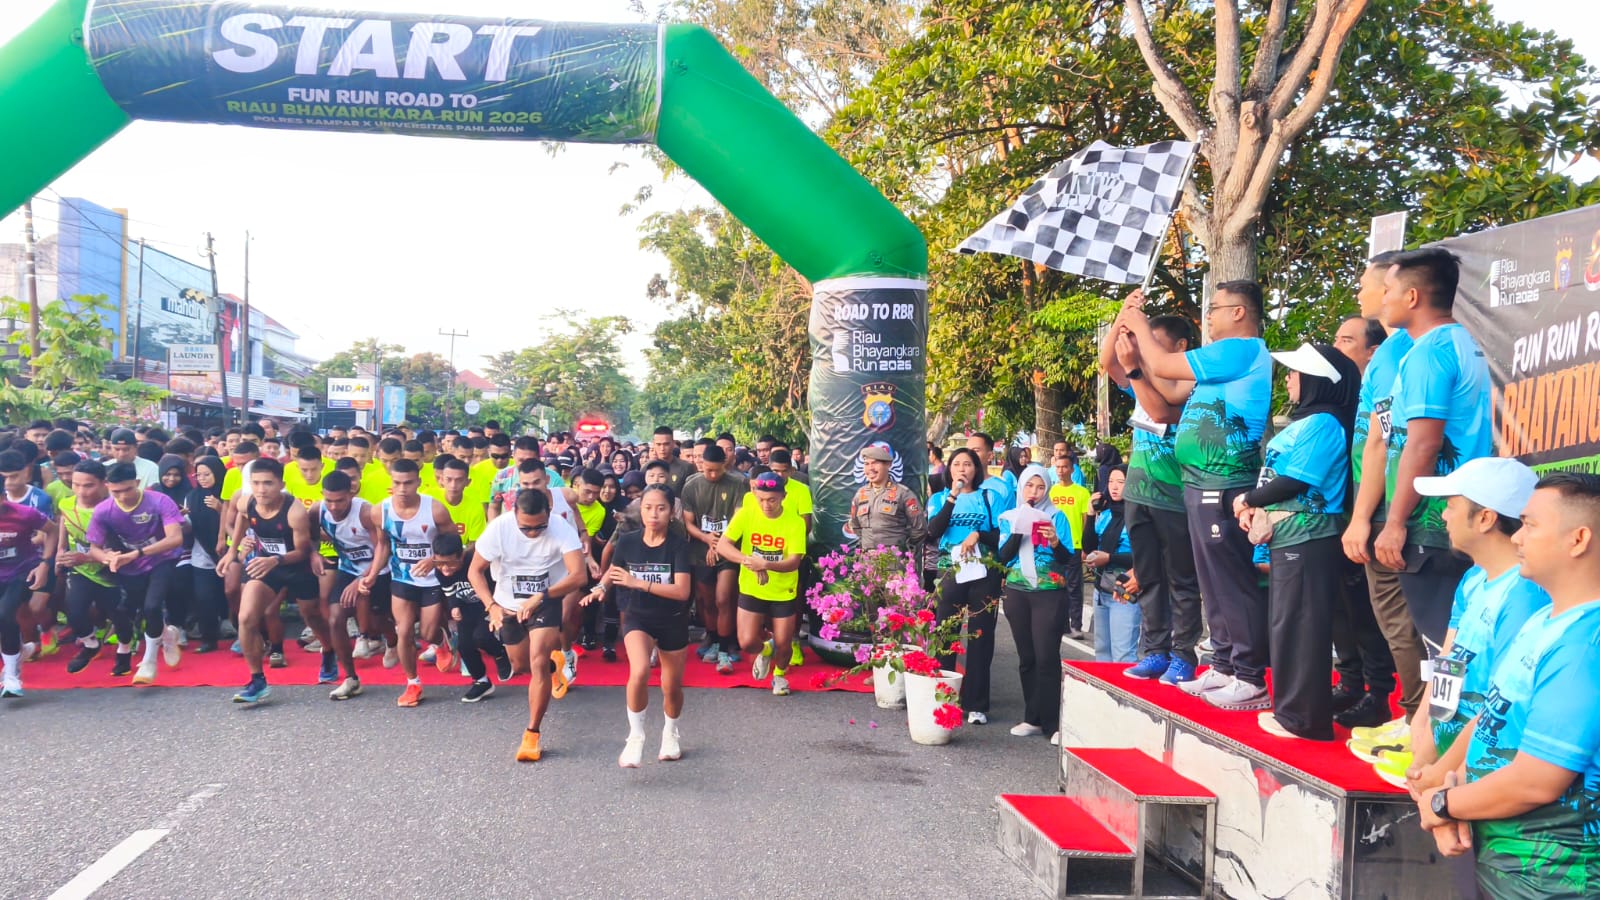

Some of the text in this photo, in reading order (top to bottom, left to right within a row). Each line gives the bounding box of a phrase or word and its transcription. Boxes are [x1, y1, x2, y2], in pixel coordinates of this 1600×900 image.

[212, 13, 543, 82] START
[288, 87, 478, 108] FUN RUN ROAD TO
[226, 101, 543, 124] RIAU BHAYANGKARA RUN 2026
[253, 115, 303, 124] POLRES
[306, 117, 359, 127] KAMPAR
[375, 121, 454, 131] UNIVERSITAS
[456, 125, 525, 133] PAHLAWAN
[1501, 259, 1518, 273] Riau
[1500, 269, 1551, 292] Bhayangkara
[1500, 289, 1540, 306] Run 2026
[834, 303, 914, 321] ROAD TO RBR
[852, 330, 881, 344] Riau
[1512, 310, 1600, 378] FUN RUN R
[852, 344, 920, 360] Bhayangkara
[853, 359, 877, 371] Run
[751, 533, 785, 549] 898
